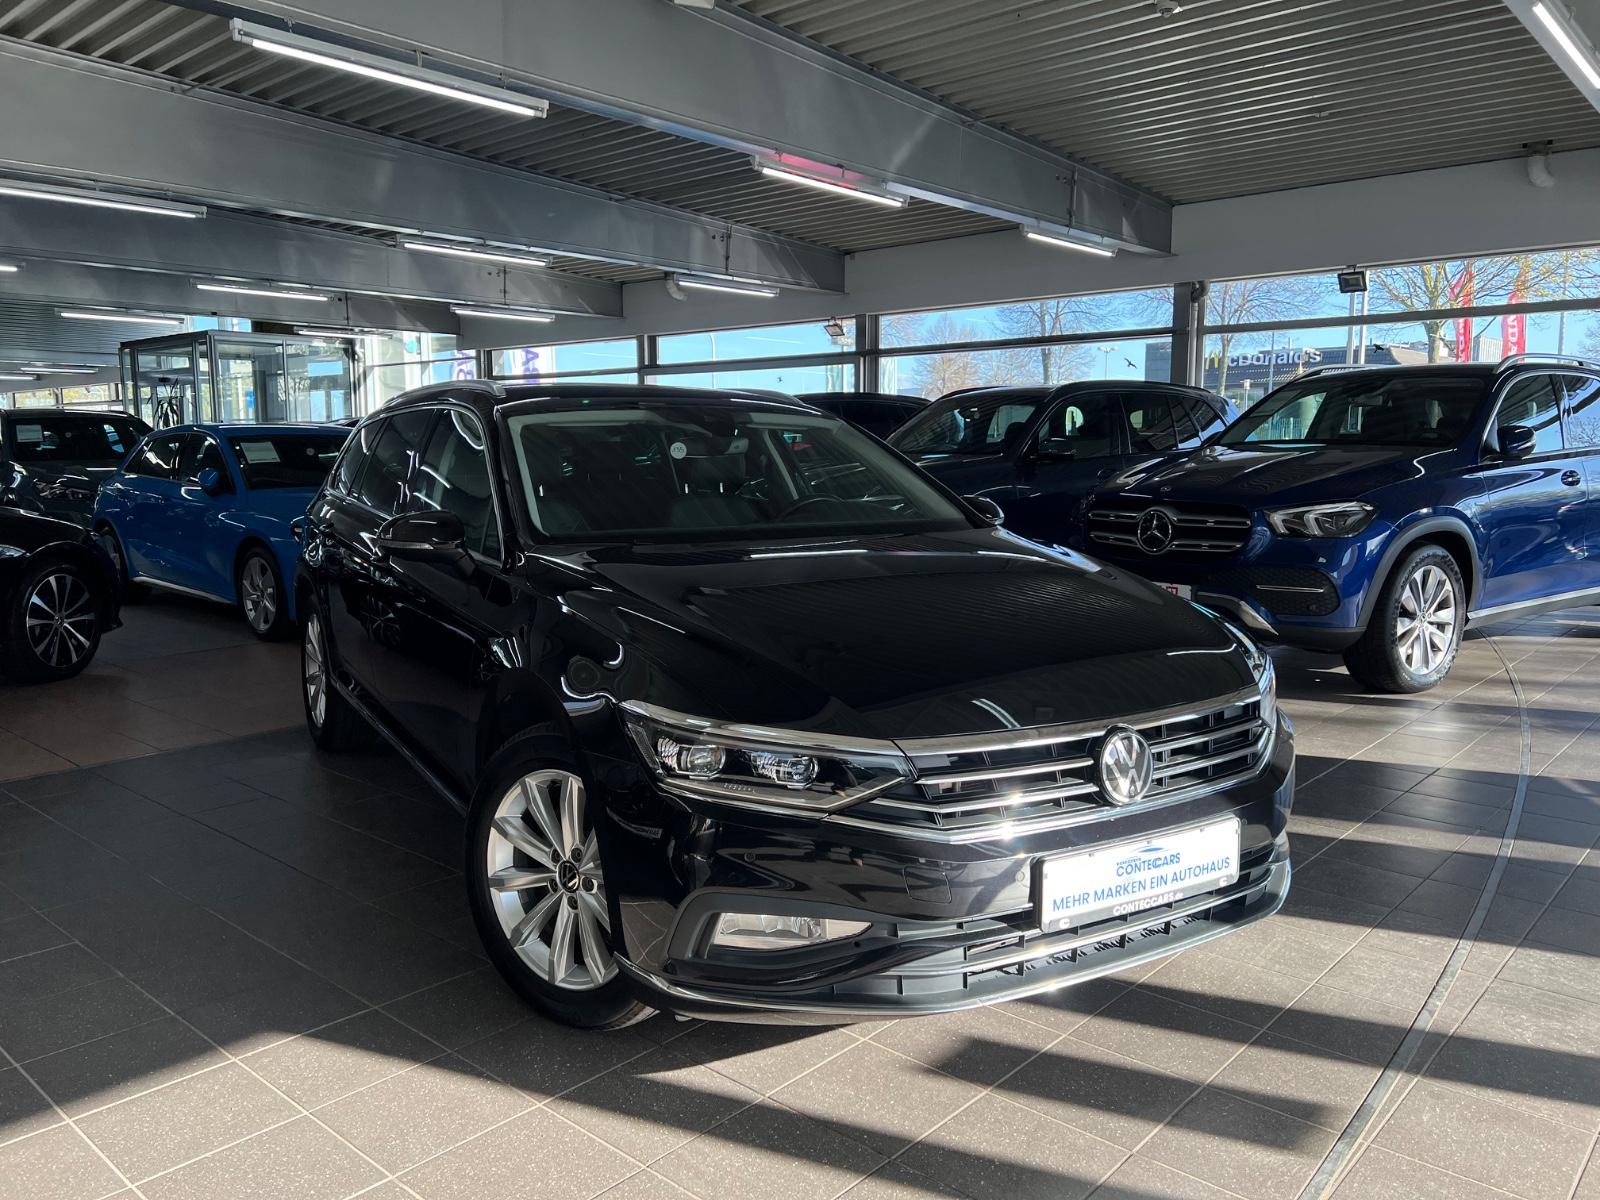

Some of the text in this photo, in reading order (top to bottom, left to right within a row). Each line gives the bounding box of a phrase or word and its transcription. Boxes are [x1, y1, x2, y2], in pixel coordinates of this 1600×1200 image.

[1052, 856, 1230, 912] MEHR MARKEN EIN AUTOHAUS
